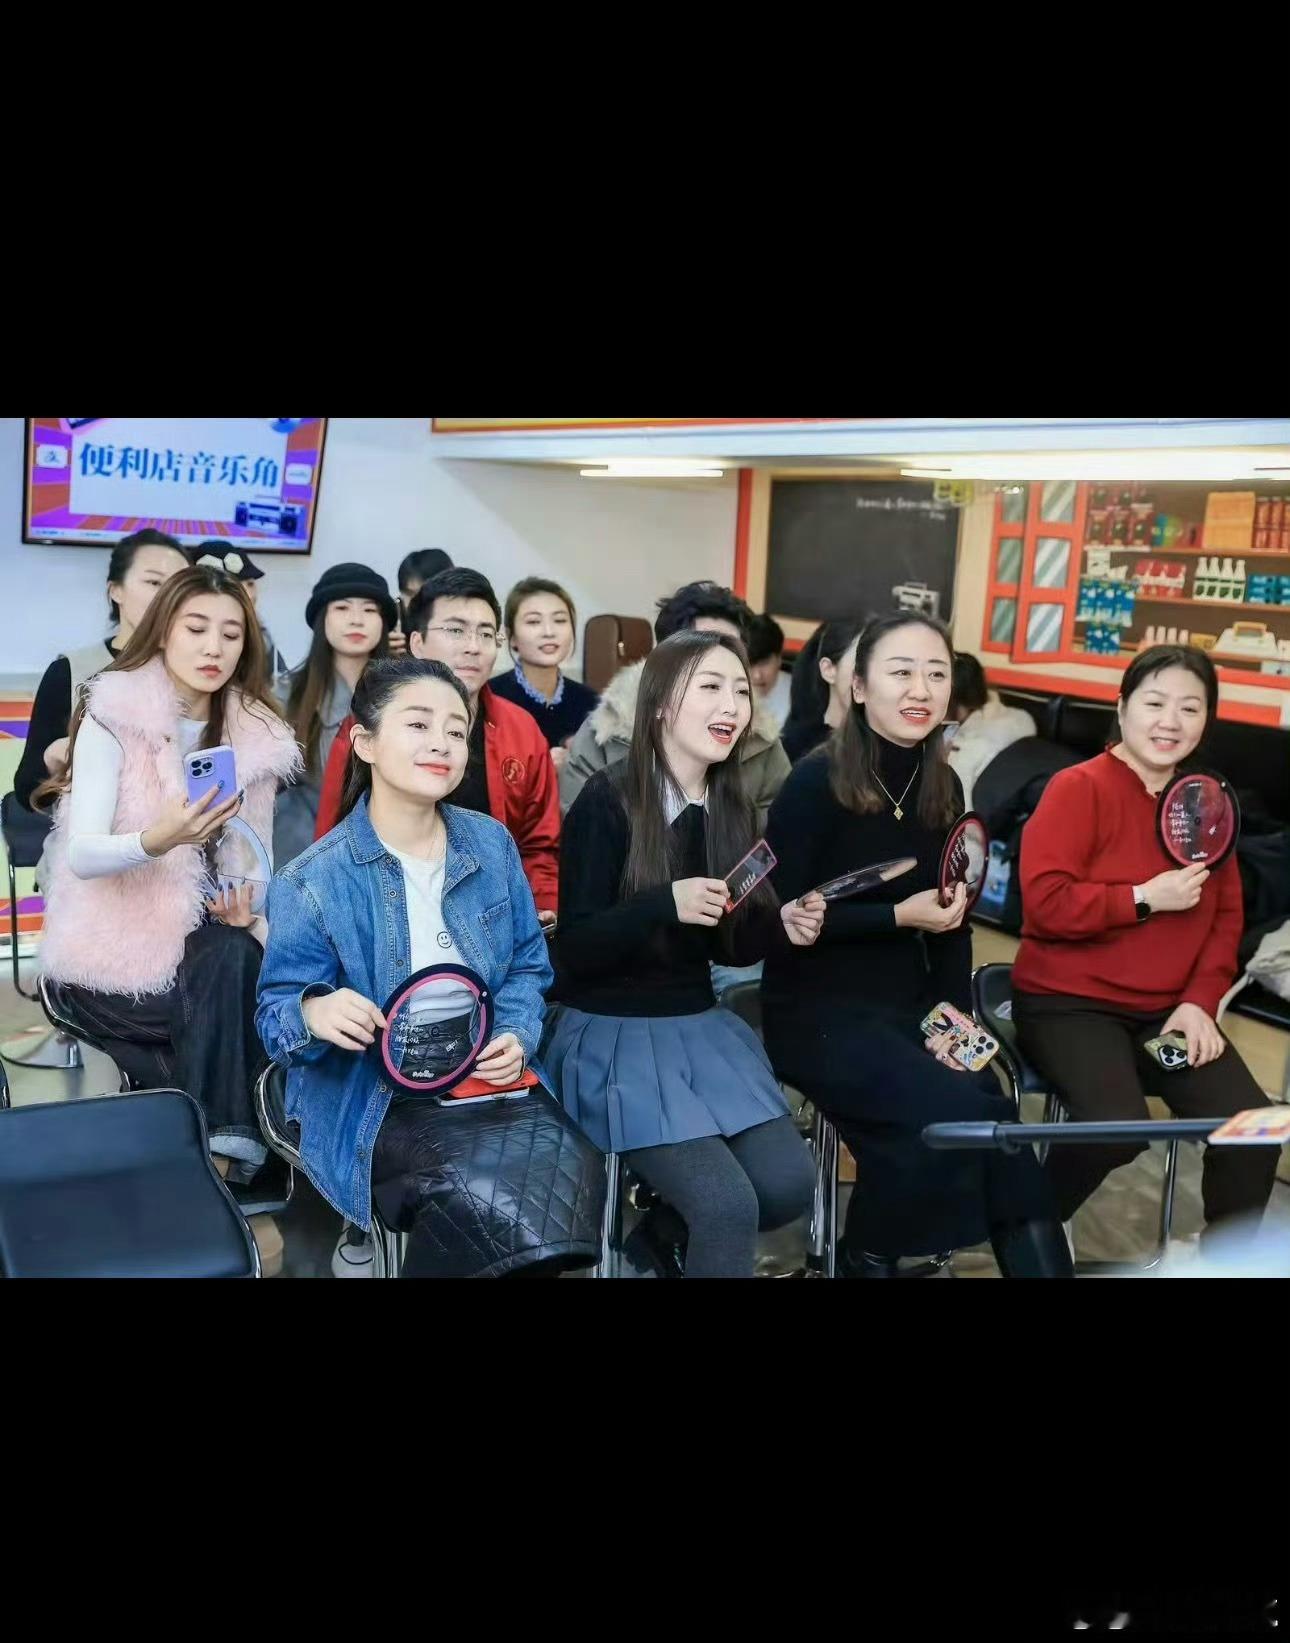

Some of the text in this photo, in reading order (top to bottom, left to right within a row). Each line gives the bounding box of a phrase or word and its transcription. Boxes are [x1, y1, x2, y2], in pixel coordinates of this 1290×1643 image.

[79, 442, 279, 488] 便利店音乐角
